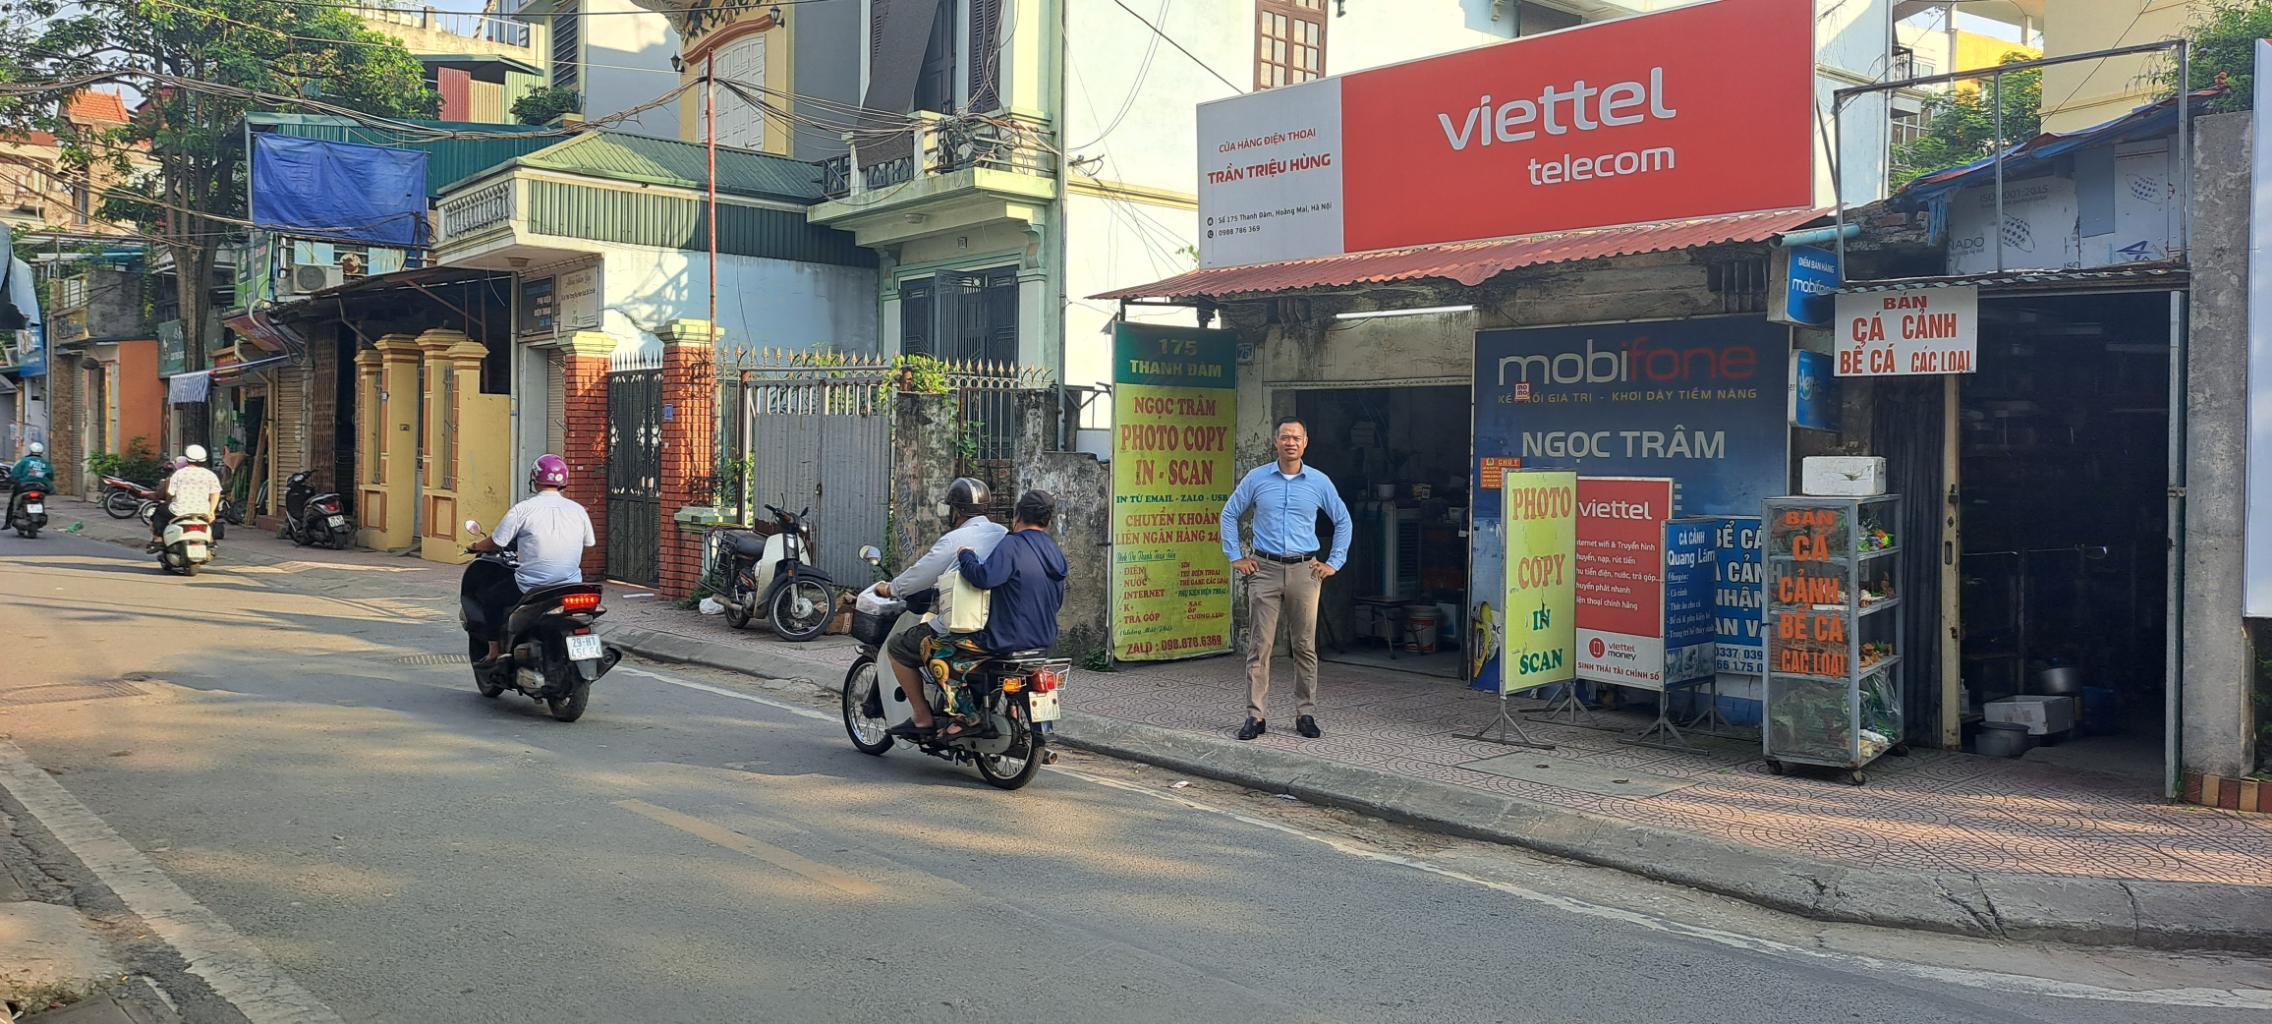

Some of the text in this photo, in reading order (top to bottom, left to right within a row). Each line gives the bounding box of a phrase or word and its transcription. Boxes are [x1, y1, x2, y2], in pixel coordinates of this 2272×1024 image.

[1437, 66, 1677, 151] viettel
[1219, 128, 1316, 153] CỬA HÀNG ĐIỆN THOẠI
[1207, 152, 1331, 185] TRẦN TRIỆU HÙNG
[1528, 147, 1675, 186] telecom
[1227, 214, 1238, 222] 175
[1240, 212, 1258, 221] Thanh
[1311, 203, 1320, 211] Hà
[1218, 225, 1261, 236] 0988 786 369
[1883, 292, 1927, 310] BÁN
[1852, 308, 1957, 342] CÁ CẢNH
[1159, 338, 1198, 357] 175
[1840, 340, 1970, 374] BỂ CÁ CÁC LOẠI
[1130, 359, 1183, 376] THANH
[1498, 336, 1758, 386] mobifone
[1134, 394, 1216, 420] NGỌC TRÂM
[1120, 424, 1228, 451] PHOTO COPY
[1522, 424, 1725, 463] NGỌC TRÂM
[1135, 459, 1214, 486] IN SCAN
[1116, 495, 1127, 503] IN
[1145, 494, 1173, 503] EMAIL
[1181, 494, 1204, 502] ZALO
[1512, 486, 1572, 520] PHOTO
[1578, 498, 1653, 520] viettel
[1125, 506, 1175, 527] CHUYỂN
[1115, 530, 1140, 545] LIÊN
[1143, 528, 1173, 544] NGÂN
[1175, 527, 1205, 543] HÀNG
[1668, 549, 1695, 568] Quang
[1518, 553, 1566, 590] COPY
[1124, 589, 1165, 600] INTERNET
[1778, 569, 1840, 605] CẢNH
[1124, 610, 1160, 624] TRẢ GÓP
[1532, 608, 1551, 631] IN
[1778, 603, 1844, 642] BỂ CÁ
[1126, 640, 1153, 656] ZALO
[1607, 650, 1637, 660] money
[1608, 641, 1635, 652] viettel
[1519, 648, 1563, 675] SCAN
[1578, 660, 1660, 680] SINH THÁI TÀI CHÍNH SỐ
[1781, 644, 1845, 679] CÁC LOẠI
